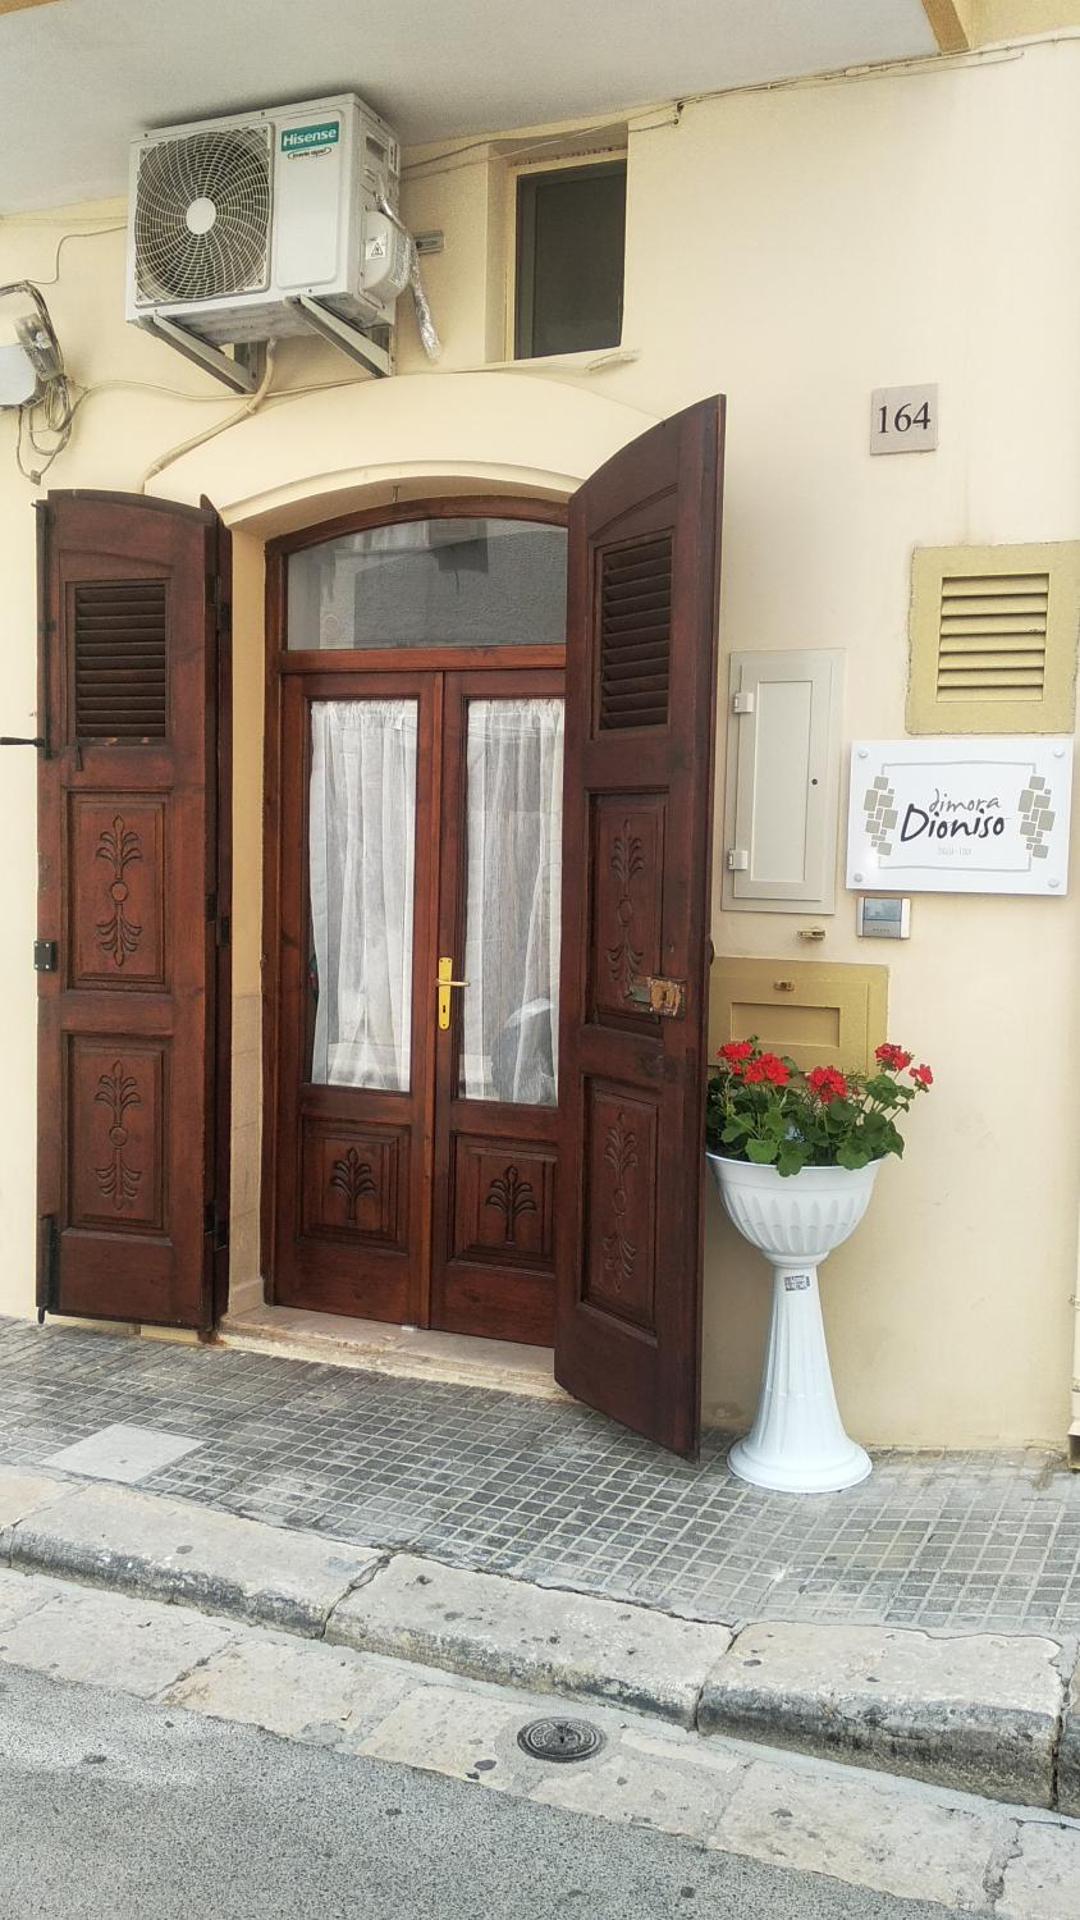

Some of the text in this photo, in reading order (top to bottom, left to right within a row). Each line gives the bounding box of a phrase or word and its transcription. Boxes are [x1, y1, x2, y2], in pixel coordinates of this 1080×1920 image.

[283, 128, 337, 147] Hisense
[879, 401, 931, 434] 164
[929, 788, 1001, 812] dimora
[900, 803, 1004, 842] Dioniso
